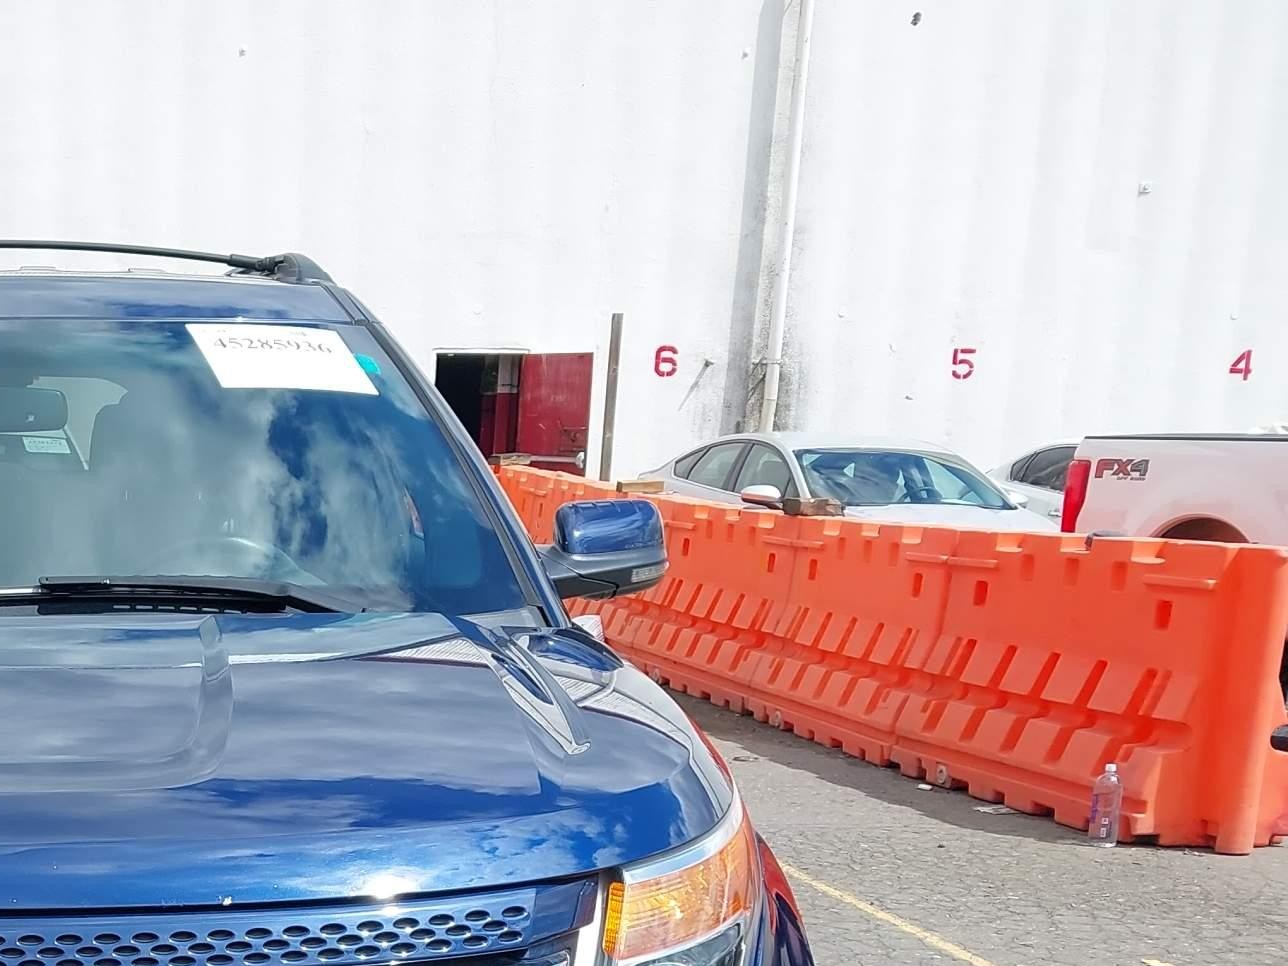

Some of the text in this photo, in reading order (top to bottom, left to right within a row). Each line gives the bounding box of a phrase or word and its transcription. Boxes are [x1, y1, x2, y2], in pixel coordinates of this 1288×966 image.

[654, 345, 678, 377] 6
[951, 348, 977, 379] 5
[1229, 349, 1253, 381] 4
[1094, 458, 1150, 479] FX4
